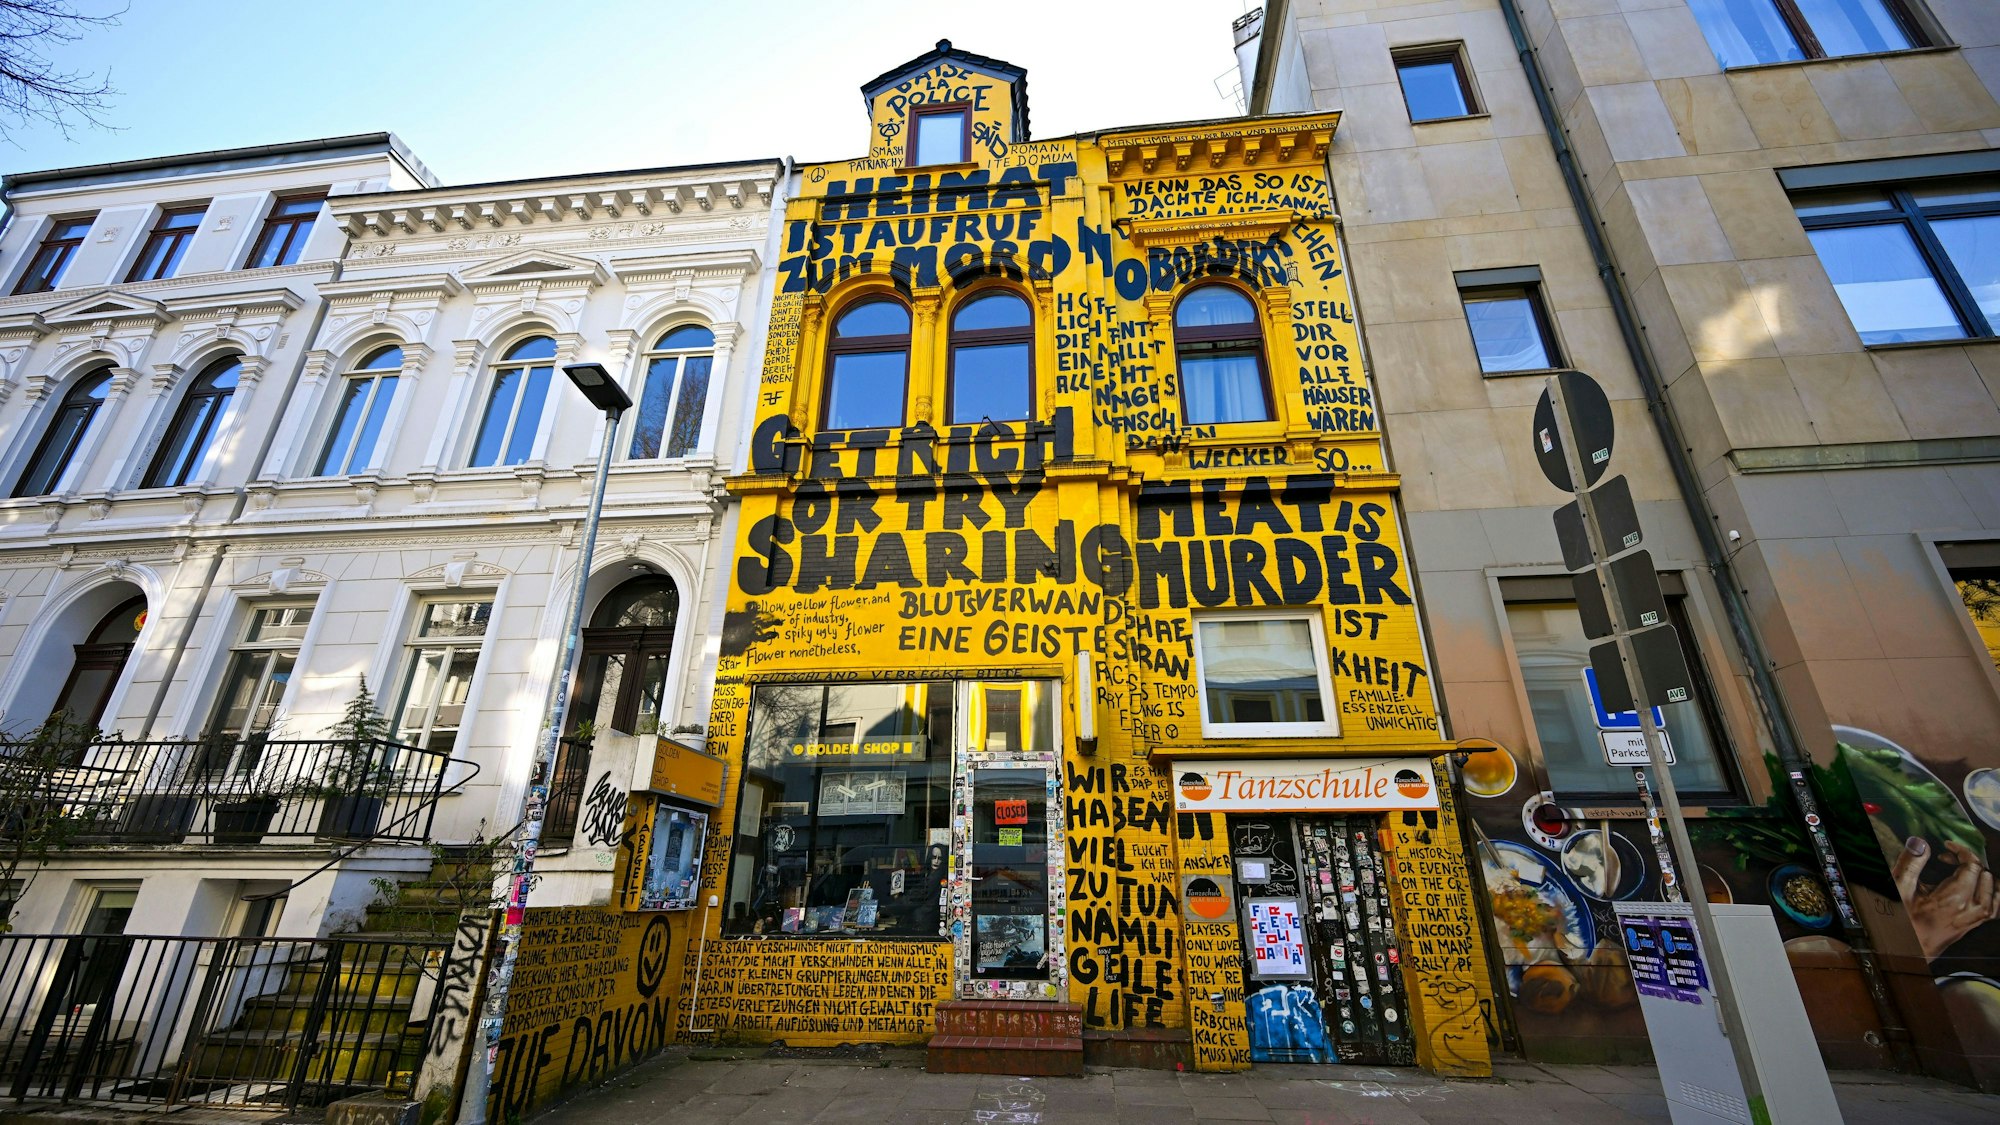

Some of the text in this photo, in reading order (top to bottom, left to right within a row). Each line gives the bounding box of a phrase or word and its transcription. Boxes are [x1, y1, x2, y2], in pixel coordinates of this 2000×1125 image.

[926, 79, 950, 90] LA
[886, 85, 993, 118] POLICE
[871, 146, 904, 157] SMASH
[1010, 143, 1065, 155] ROMANI
[848, 157, 904, 173] PATRIARCHY
[987, 151, 1074, 169] ITE DOMUM
[821, 162, 1077, 221] HEIMAT
[1123, 179, 1189, 198] WENN
[1200, 174, 1242, 192] DAS
[1254, 172, 1284, 190] SO
[1129, 190, 1216, 214] DACHTE
[1292, 300, 1353, 323] STELL
[768, 330, 800, 340] SONDERN
[1292, 323, 1337, 342] DIR
[764, 355, 791, 366] GENDE
[1296, 345, 1348, 362] VOR
[1300, 366, 1355, 385] ALLE
[1303, 385, 1371, 408] HÄUSER
[1306, 406, 1374, 433] WÄREN
[1188, 446, 1288, 470] WECKER
[1593, 449, 1608, 461] AVB
[792, 470, 1046, 534] OR TRY
[1136, 475, 1386, 542] MEAT IS
[1624, 533, 1638, 546] AVB
[737, 513, 1134, 596] SHARING
[1135, 535, 1412, 609] MURDER
[787, 591, 890, 617] yellow and
[790, 612, 849, 628] of industry,
[1334, 608, 1388, 640] IST
[1642, 612, 1657, 623] AVB
[785, 627, 812, 644] spiky
[816, 627, 838, 640] ugly
[845, 622, 885, 640] flower
[899, 625, 972, 653] EINE
[746, 642, 861, 667] Flower nonetheless,
[718, 657, 741, 671] Star
[749, 670, 858, 683] DEUTSCHLAND
[977, 668, 1023, 678] BITTE
[714, 687, 736, 697] MUSS
[1668, 688, 1685, 699] AVB
[1343, 703, 1423, 715] ESSENZIELL
[708, 723, 737, 739] BULLE
[1366, 716, 1437, 731] UNWICHTIG
[706, 741, 729, 756] SEIN
[807, 742, 900, 756] GOLDEN SHOP
[1628, 738, 1644, 747] mit
[653, 774, 669, 787] SHOP
[1067, 762, 1130, 794] WIR
[1217, 767, 1389, 800] Tanzschule
[996, 805, 1026, 820] CLOSED
[1398, 832, 1410, 844] IS
[1068, 837, 1134, 872] VIEL
[1132, 844, 1168, 858] FLUCHT
[1141, 857, 1157, 870] ICH
[1184, 854, 1230, 869] ANSWER
[1399, 862, 1451, 876] OR EVEN
[1068, 868, 1109, 900] ZU
[1402, 877, 1444, 890] ON THE
[1187, 887, 1221, 897] Tanzschule
[1425, 893, 1441, 907] OF
[1252, 904, 1281, 921] FÜR
[1418, 907, 1450, 922] THAT
[527, 928, 559, 946] IMMER
[1186, 923, 1231, 937] PLAYERS
[704, 940, 851, 954] DER STAAT VERSCHWINDET NICHT
[1187, 939, 1240, 951] ONLY LOVE
[1419, 939, 1434, 955] IN
[552, 944, 618, 963] KONTROLLE UND
[1188, 954, 1242, 968] YOU WHEN
[581, 956, 630, 980] JAHRELANG
[763, 955, 796, 968] MACHT
[800, 955, 874, 968] VERSCHWINDEN
[877, 957, 894, 968] WENN
[936, 957, 947, 970] IN
[748, 968, 792, 980] KLEINEN
[892, 971, 911, 983] UND
[913, 971, 930, 984] SEI
[934, 972, 948, 986] ES
[1190, 970, 1216, 985] THEY
[555, 981, 595, 1002] KONSUM
[597, 978, 615, 998] DER
[681, 979, 938, 999] IM IN ÜBERTRETUNGEN IN DENEN DIE
[824, 1000, 932, 1017] NICHT GEWALT IST
[1086, 986, 1166, 1030] LIFE
[676, 1011, 729, 1029] SONDERN
[776, 1016, 839, 1033] AUFLÖSUNG
[842, 1018, 864, 1032] UND
[868, 1017, 931, 1034] METAMOR-
[562, 995, 670, 1090] DAVON
[1195, 1027, 1238, 1047] KACKE
[1199, 1046, 1251, 1065] MUSS WEG
